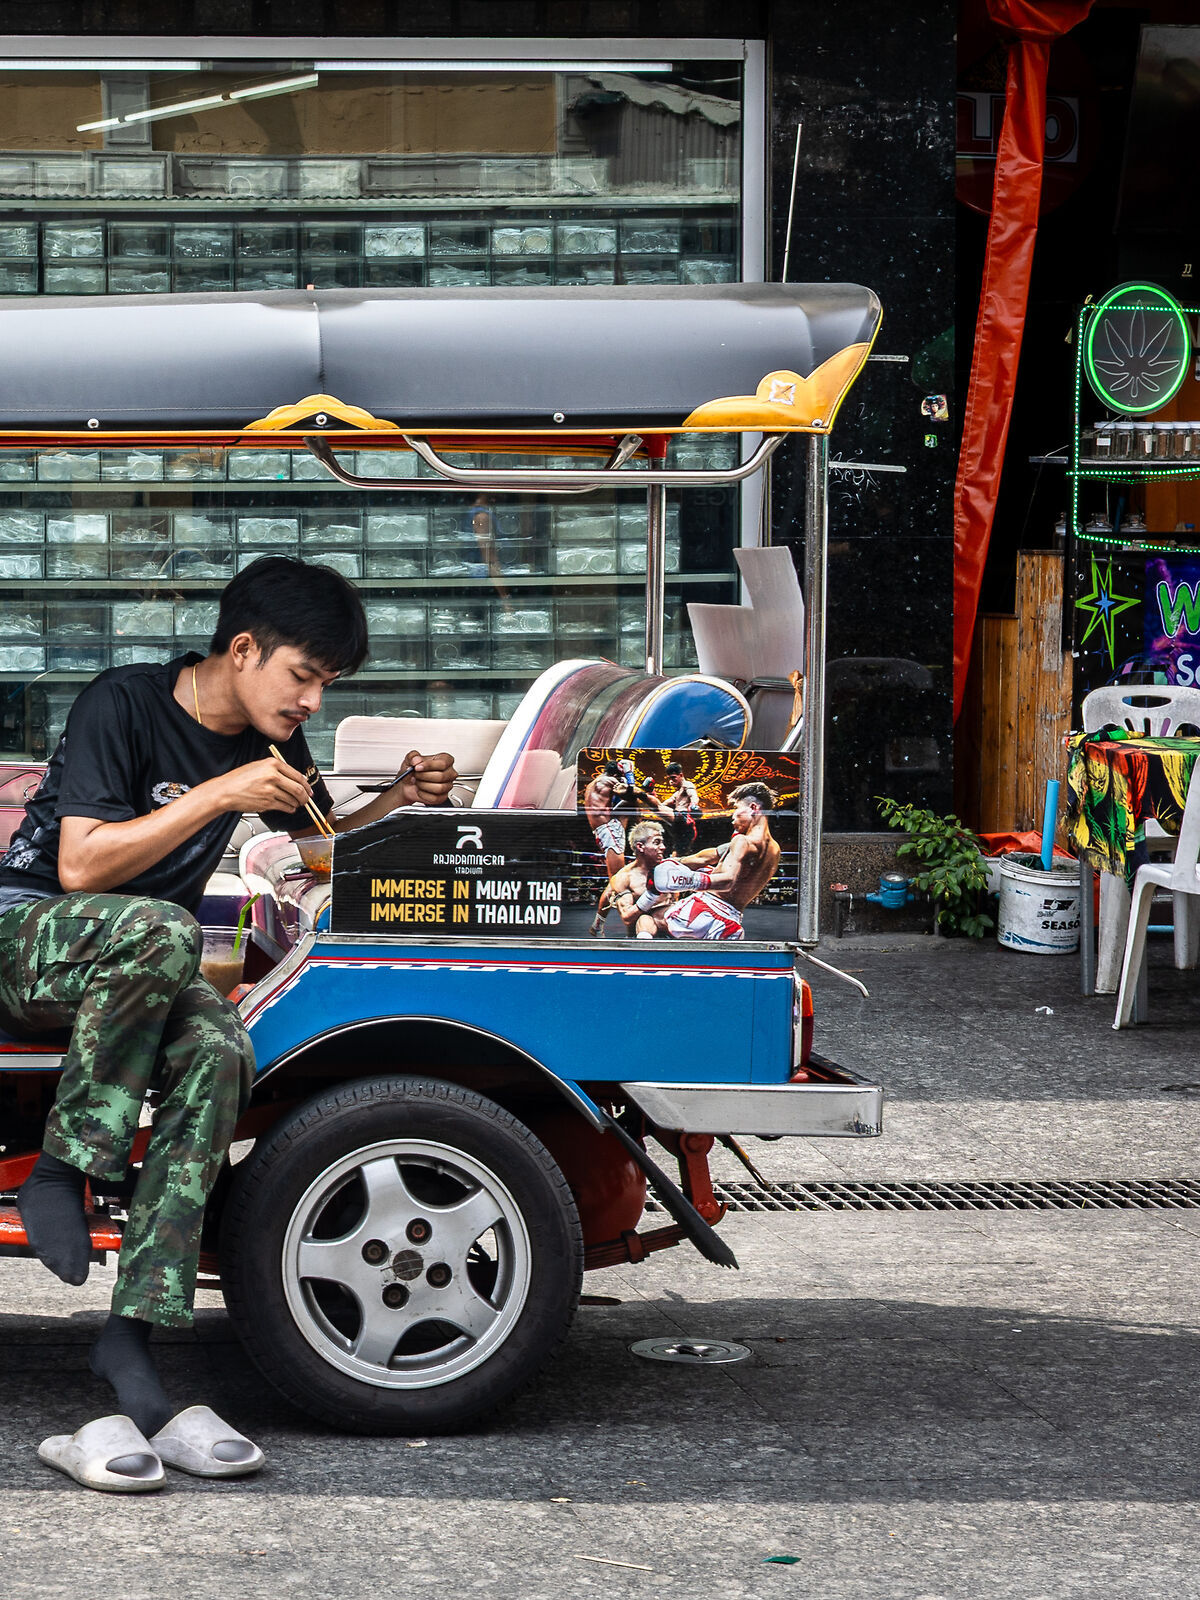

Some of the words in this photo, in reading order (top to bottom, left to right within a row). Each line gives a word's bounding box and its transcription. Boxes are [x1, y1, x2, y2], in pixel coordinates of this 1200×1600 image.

[454, 866, 483, 875] STADIUM
[370, 878, 447, 899] IMMERSE
[452, 879, 470, 899] IN
[475, 880, 522, 901] MUAY
[526, 881, 562, 901] THAI
[370, 902, 446, 923] IMMERSE
[452, 903, 470, 923] IN
[475, 904, 562, 925] THAILAND
